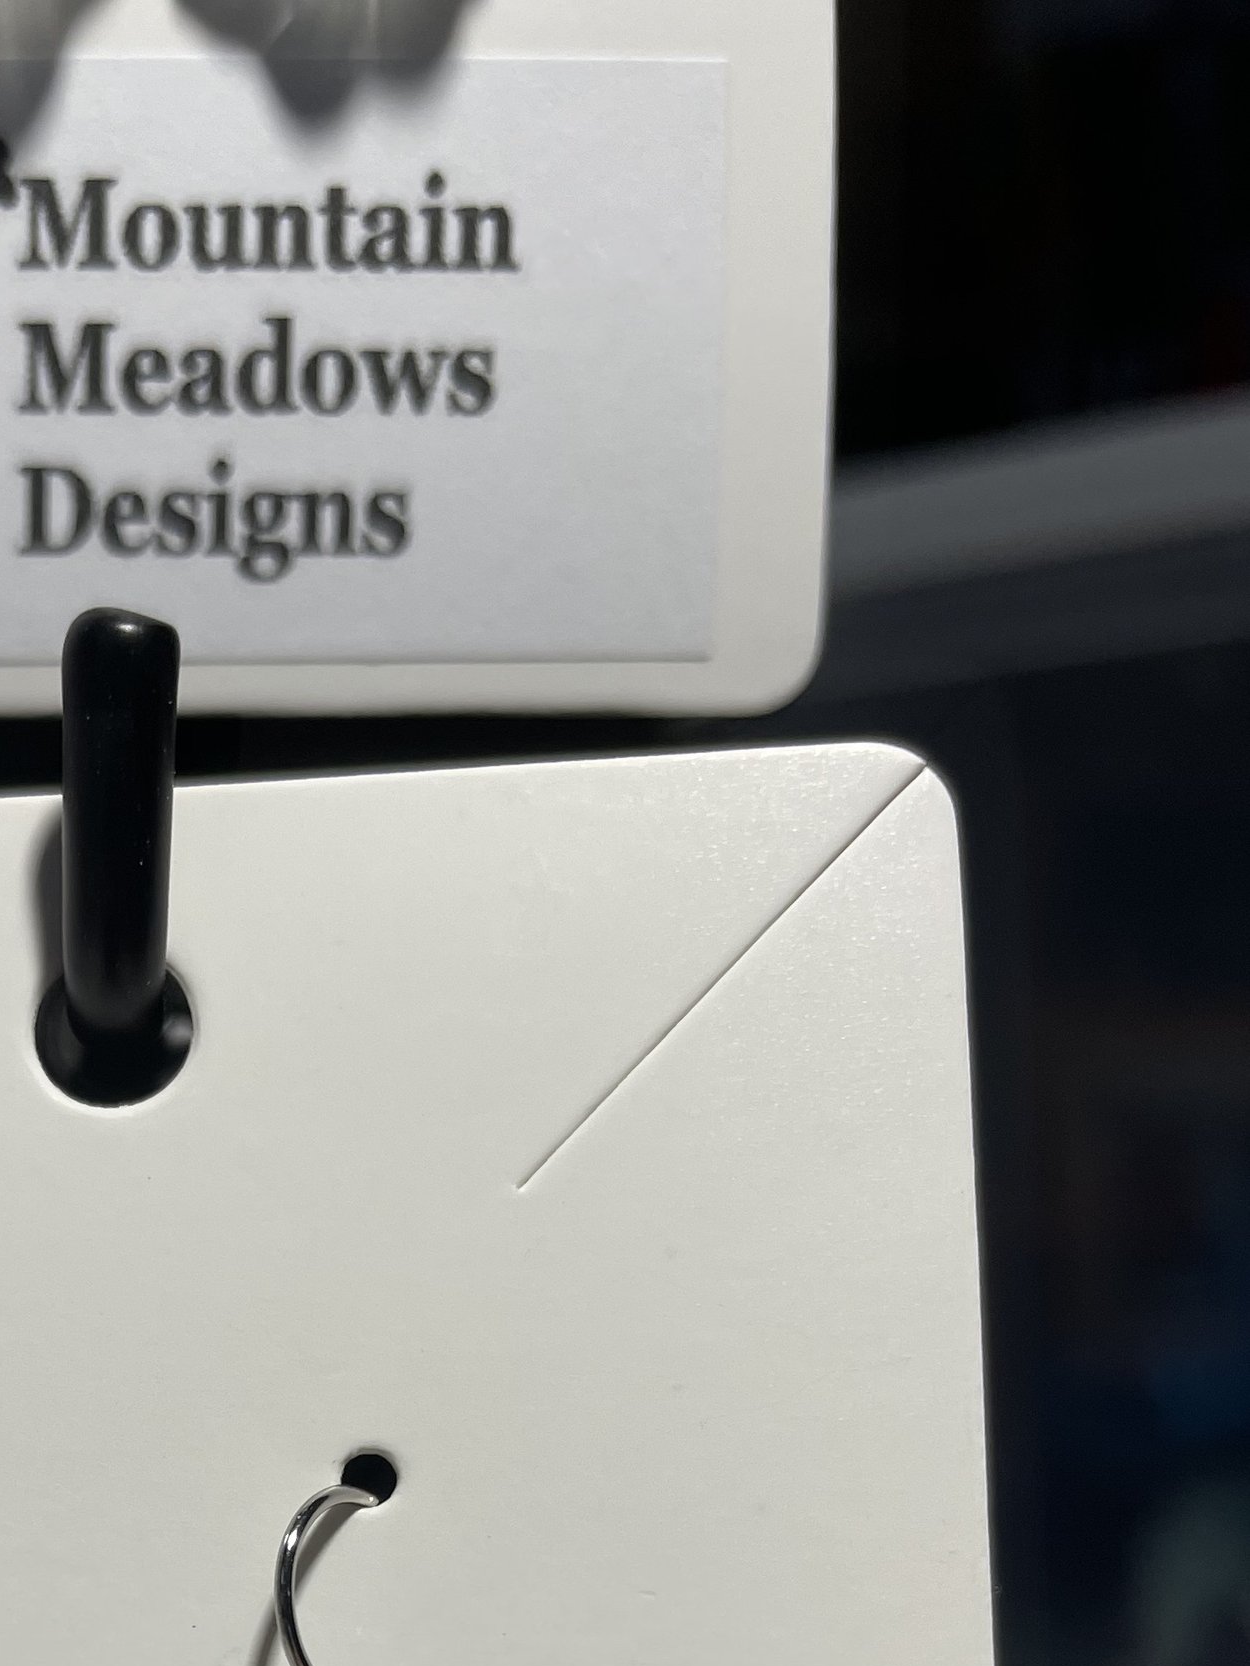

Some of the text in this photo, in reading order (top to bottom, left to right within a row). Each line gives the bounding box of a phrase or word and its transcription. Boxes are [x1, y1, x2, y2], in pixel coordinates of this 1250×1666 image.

[19, 171, 520, 273] Mountain
[18, 317, 496, 416] Meadows
[18, 459, 412, 583] Designs
